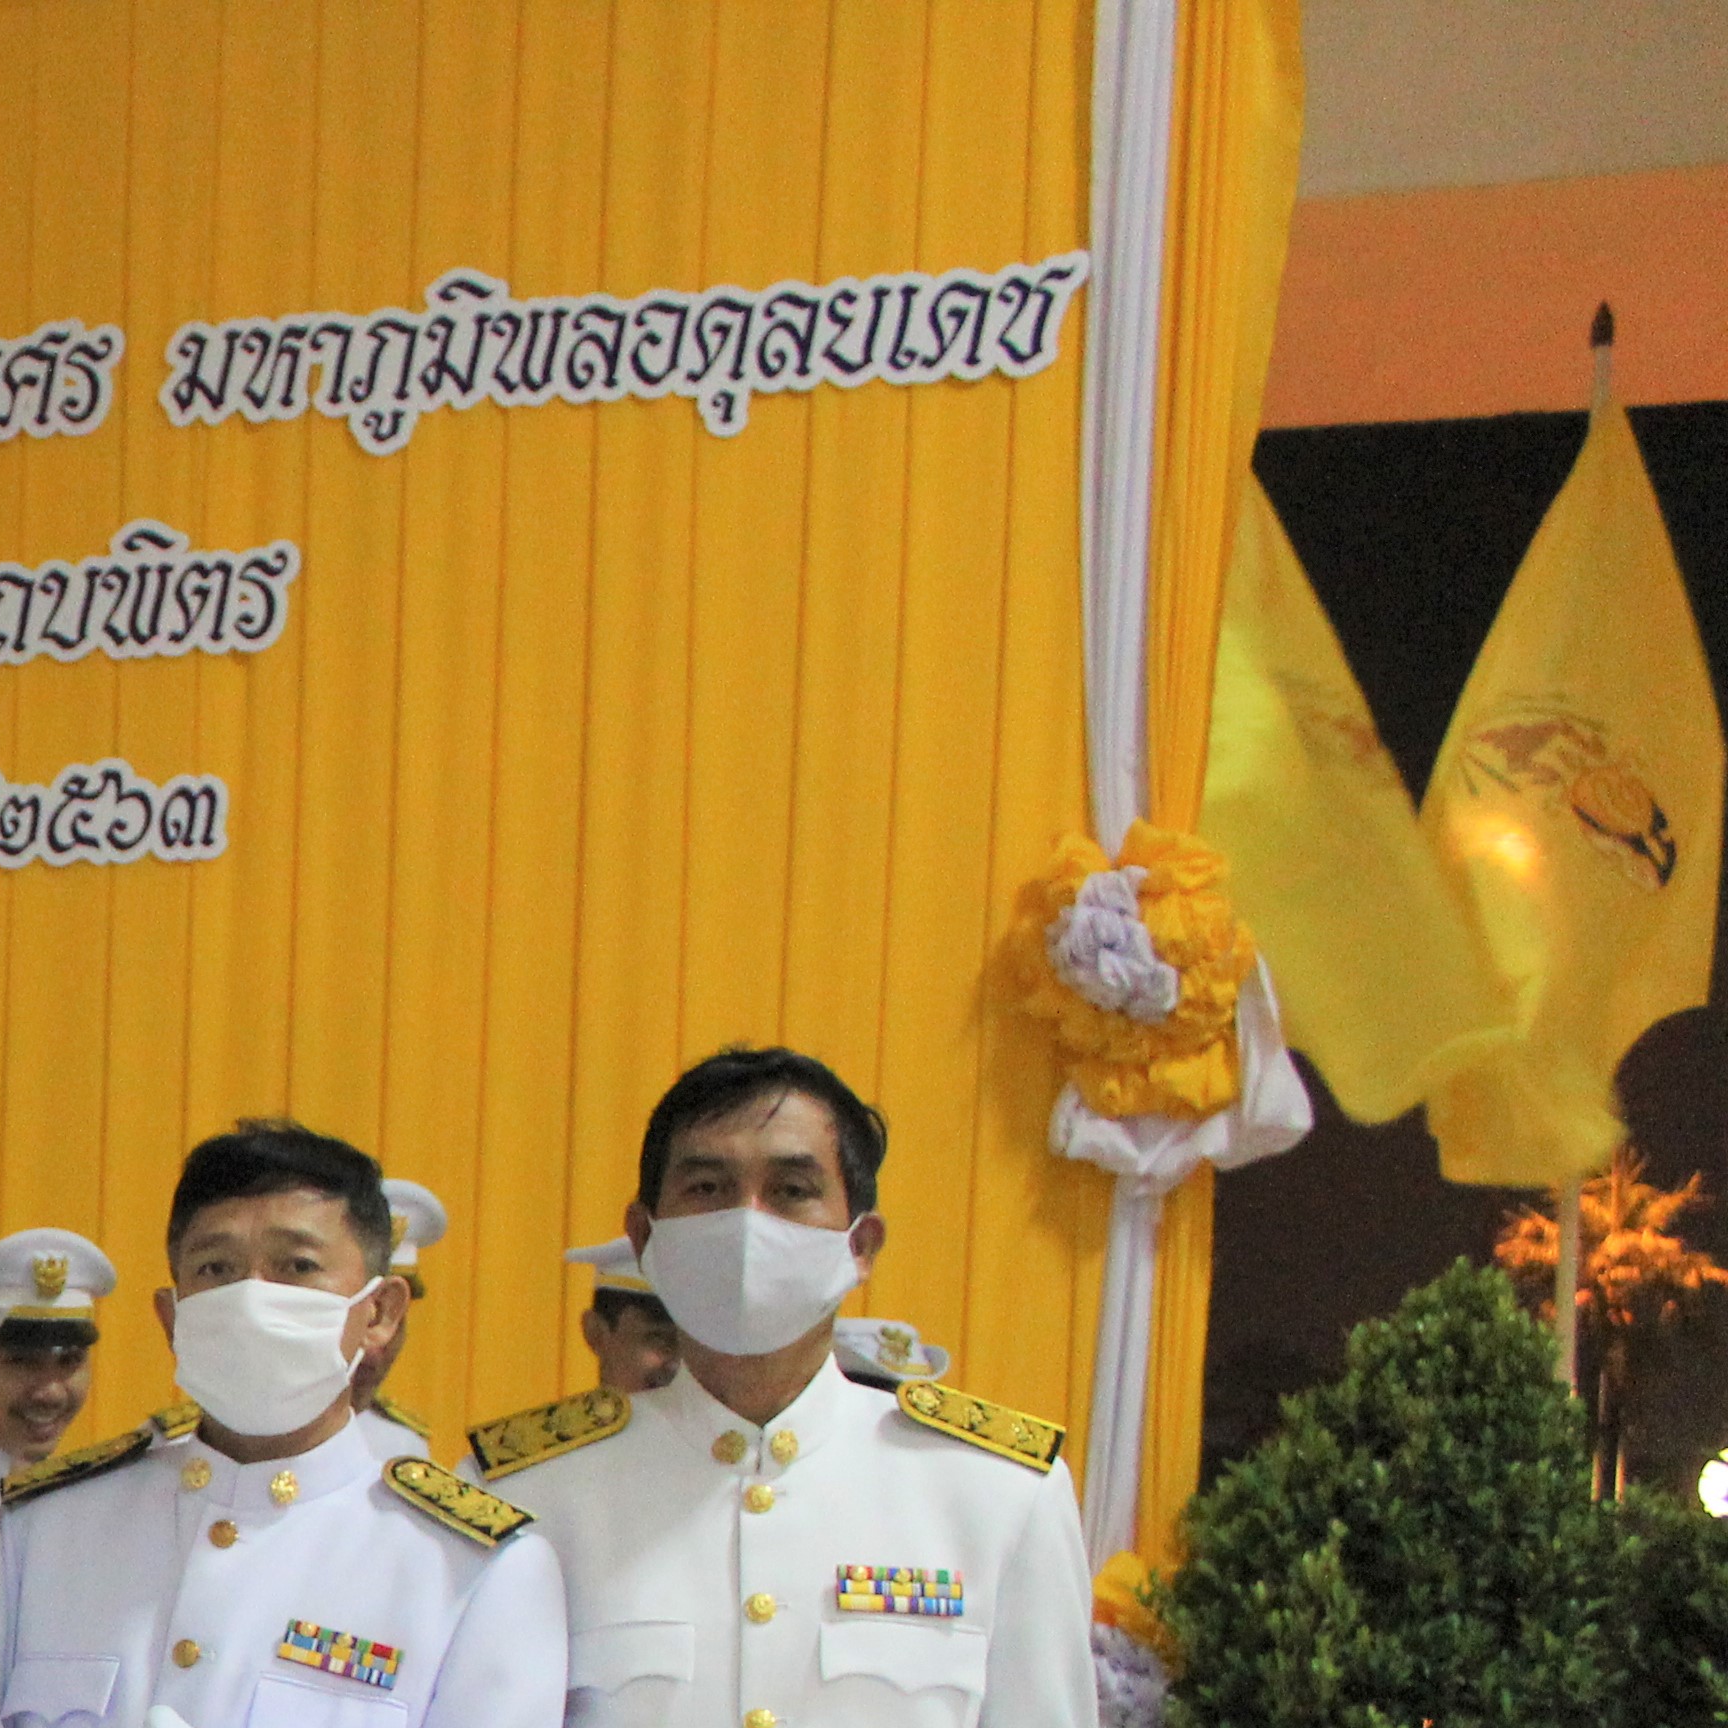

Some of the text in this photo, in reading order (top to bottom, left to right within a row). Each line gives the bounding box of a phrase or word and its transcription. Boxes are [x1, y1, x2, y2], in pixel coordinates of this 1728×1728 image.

[169, 264, 1076, 443] มหาภูมิพลอดุลยเดช
